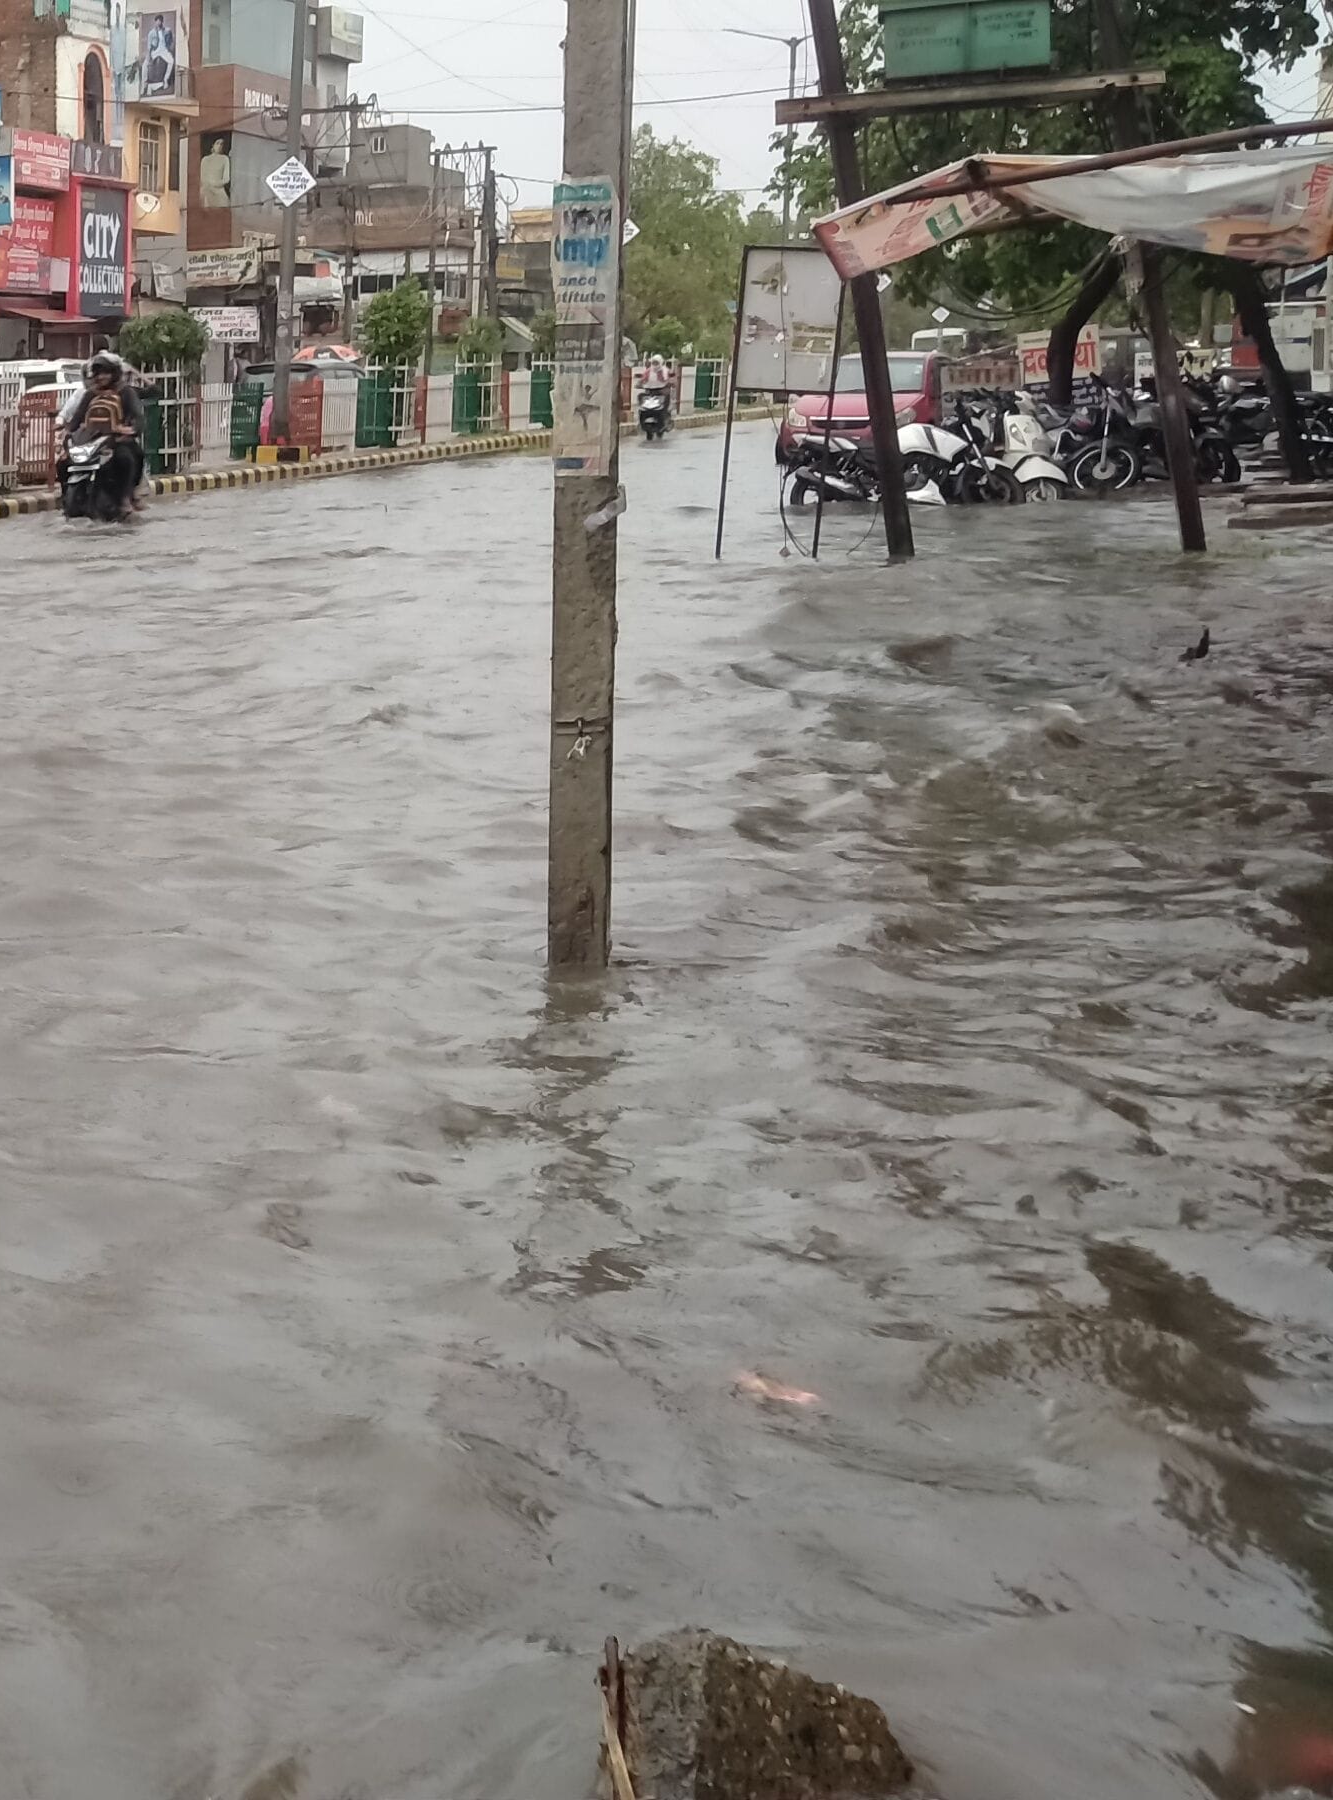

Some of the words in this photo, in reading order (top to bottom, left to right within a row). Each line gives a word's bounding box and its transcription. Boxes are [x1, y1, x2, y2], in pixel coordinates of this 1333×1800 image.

[83, 211, 121, 263] CITY
[78, 263, 125, 296] COLLECTION
[556, 289, 606, 303] titute
